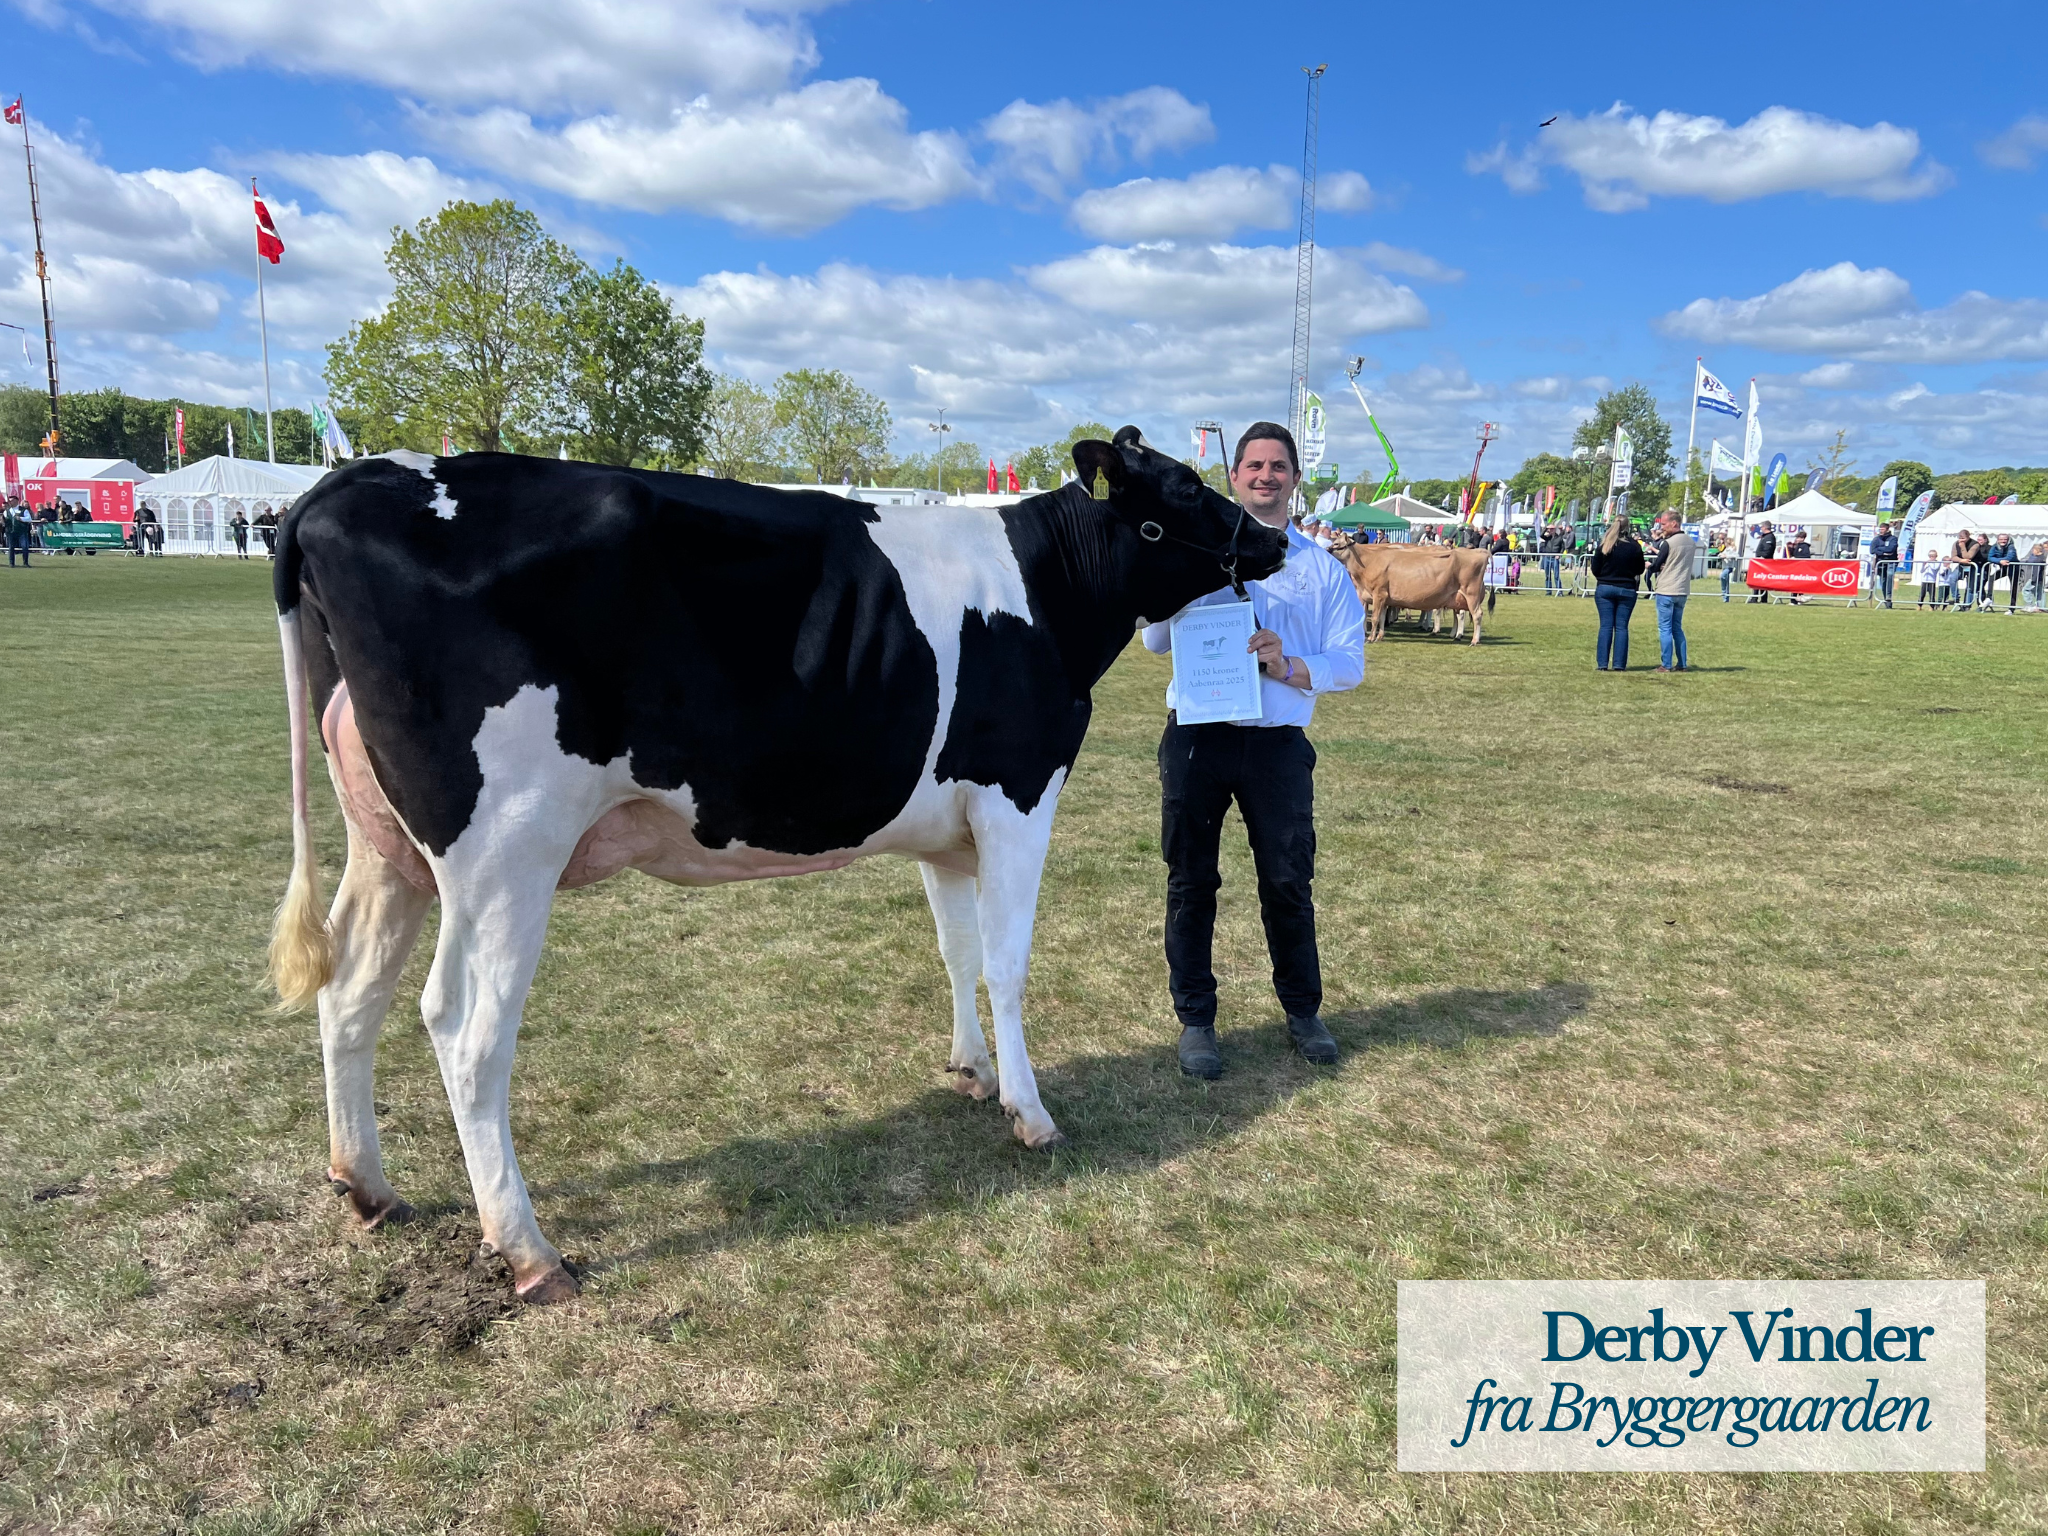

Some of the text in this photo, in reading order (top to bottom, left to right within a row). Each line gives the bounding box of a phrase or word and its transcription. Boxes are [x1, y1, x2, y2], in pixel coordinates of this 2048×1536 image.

[27, 483, 43, 491] OK
[1904, 520, 1914, 532] JB
[1753, 572, 1767, 581] Lely
[1768, 573, 1789, 581] Center
[1828, 571, 1848, 584] LELY
[1182, 620, 1241, 632] DERBY VINDER
[1192, 666, 1239, 677] 1150 kroner
[1187, 676, 1245, 688] Aabenraa 2025
